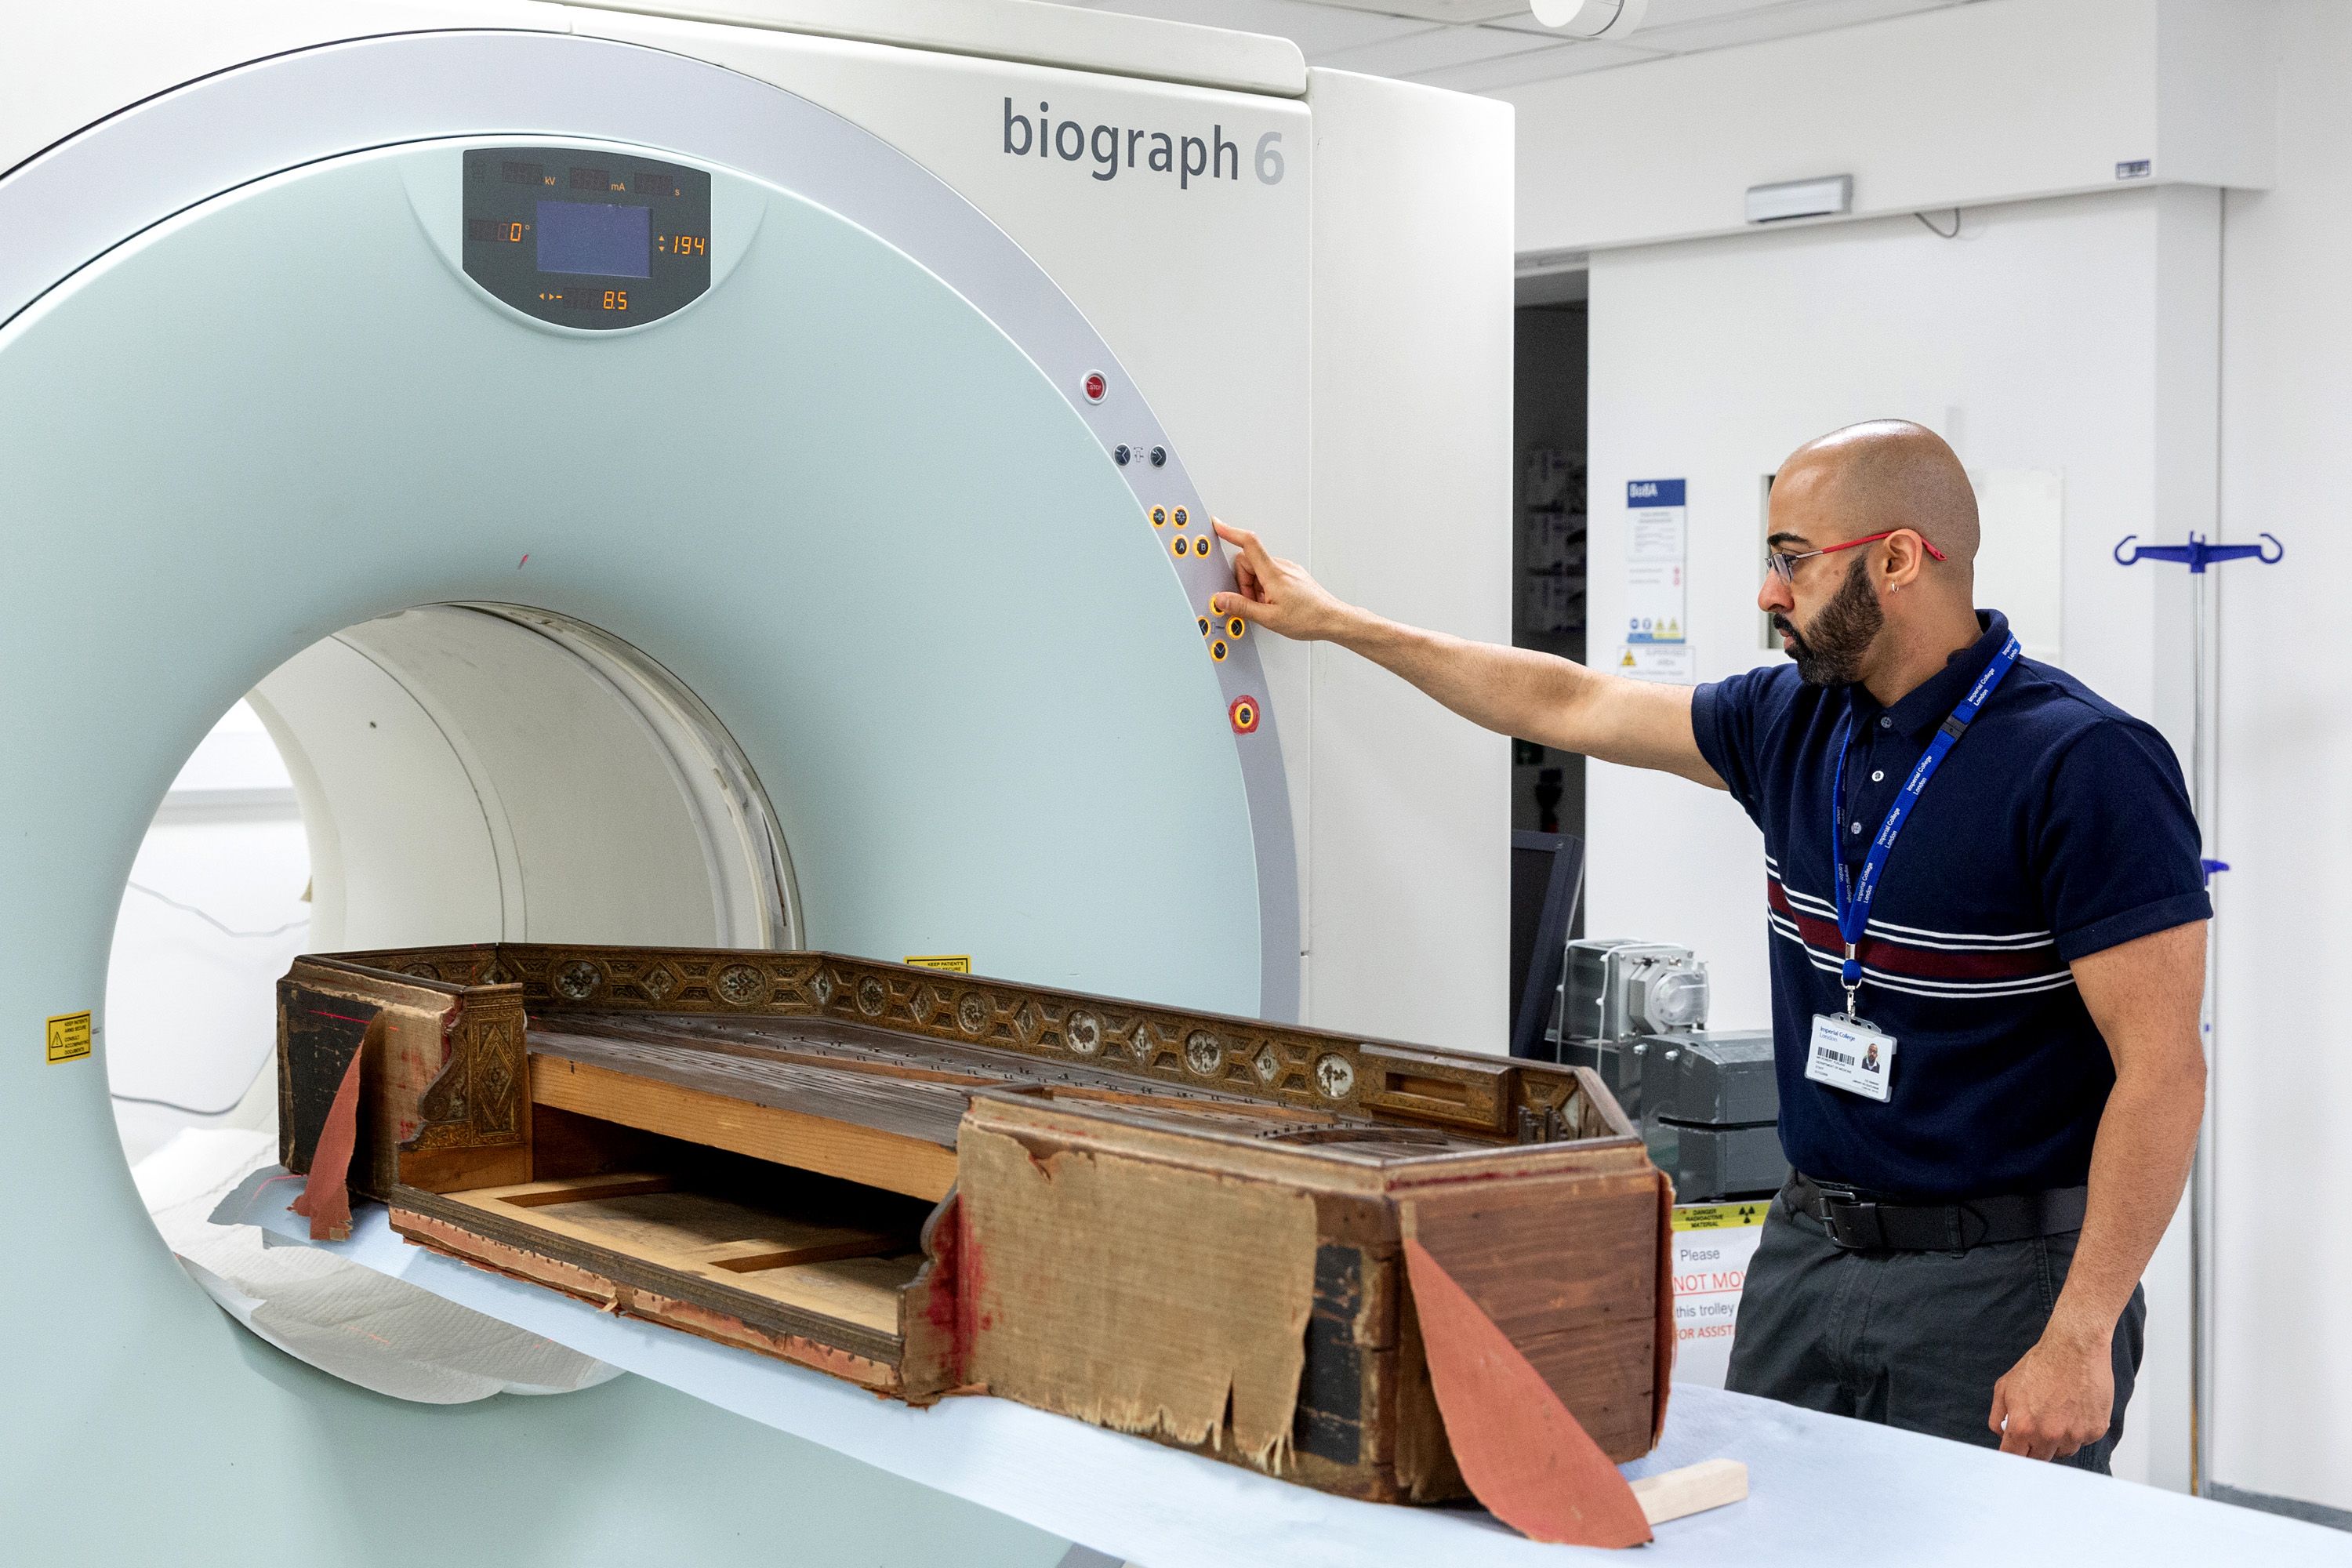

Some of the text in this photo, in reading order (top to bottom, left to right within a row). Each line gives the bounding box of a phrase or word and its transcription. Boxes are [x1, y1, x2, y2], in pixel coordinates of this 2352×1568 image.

[1004, 96, 1286, 190] biograph 6
[545, 176, 556, 186] kV
[611, 182, 626, 191] mA
[673, 235, 705, 256] 194
[1178, 542, 1185, 550] A
[1200, 543, 1207, 551] B
[1967, 668, 1995, 702] Imperial College
[1973, 689, 1989, 706] London
[1906, 755, 1933, 792] Imperial College
[1912, 777, 1928, 796] London
[1877, 808, 1900, 845] Imperial College
[1884, 830, 1898, 849] London
[1856, 862, 1873, 902] Imperial College
[1863, 885, 1873, 904] London
[1819, 1033, 1838, 1042] London
[1820, 1026, 1856, 1042] Imperial College
[1680, 1249, 1720, 1262] Please
[1673, 1274, 1707, 1292] NOT
[1676, 1302, 1734, 1318] this trolley
[1697, 1324, 1734, 1338] ASSIST
